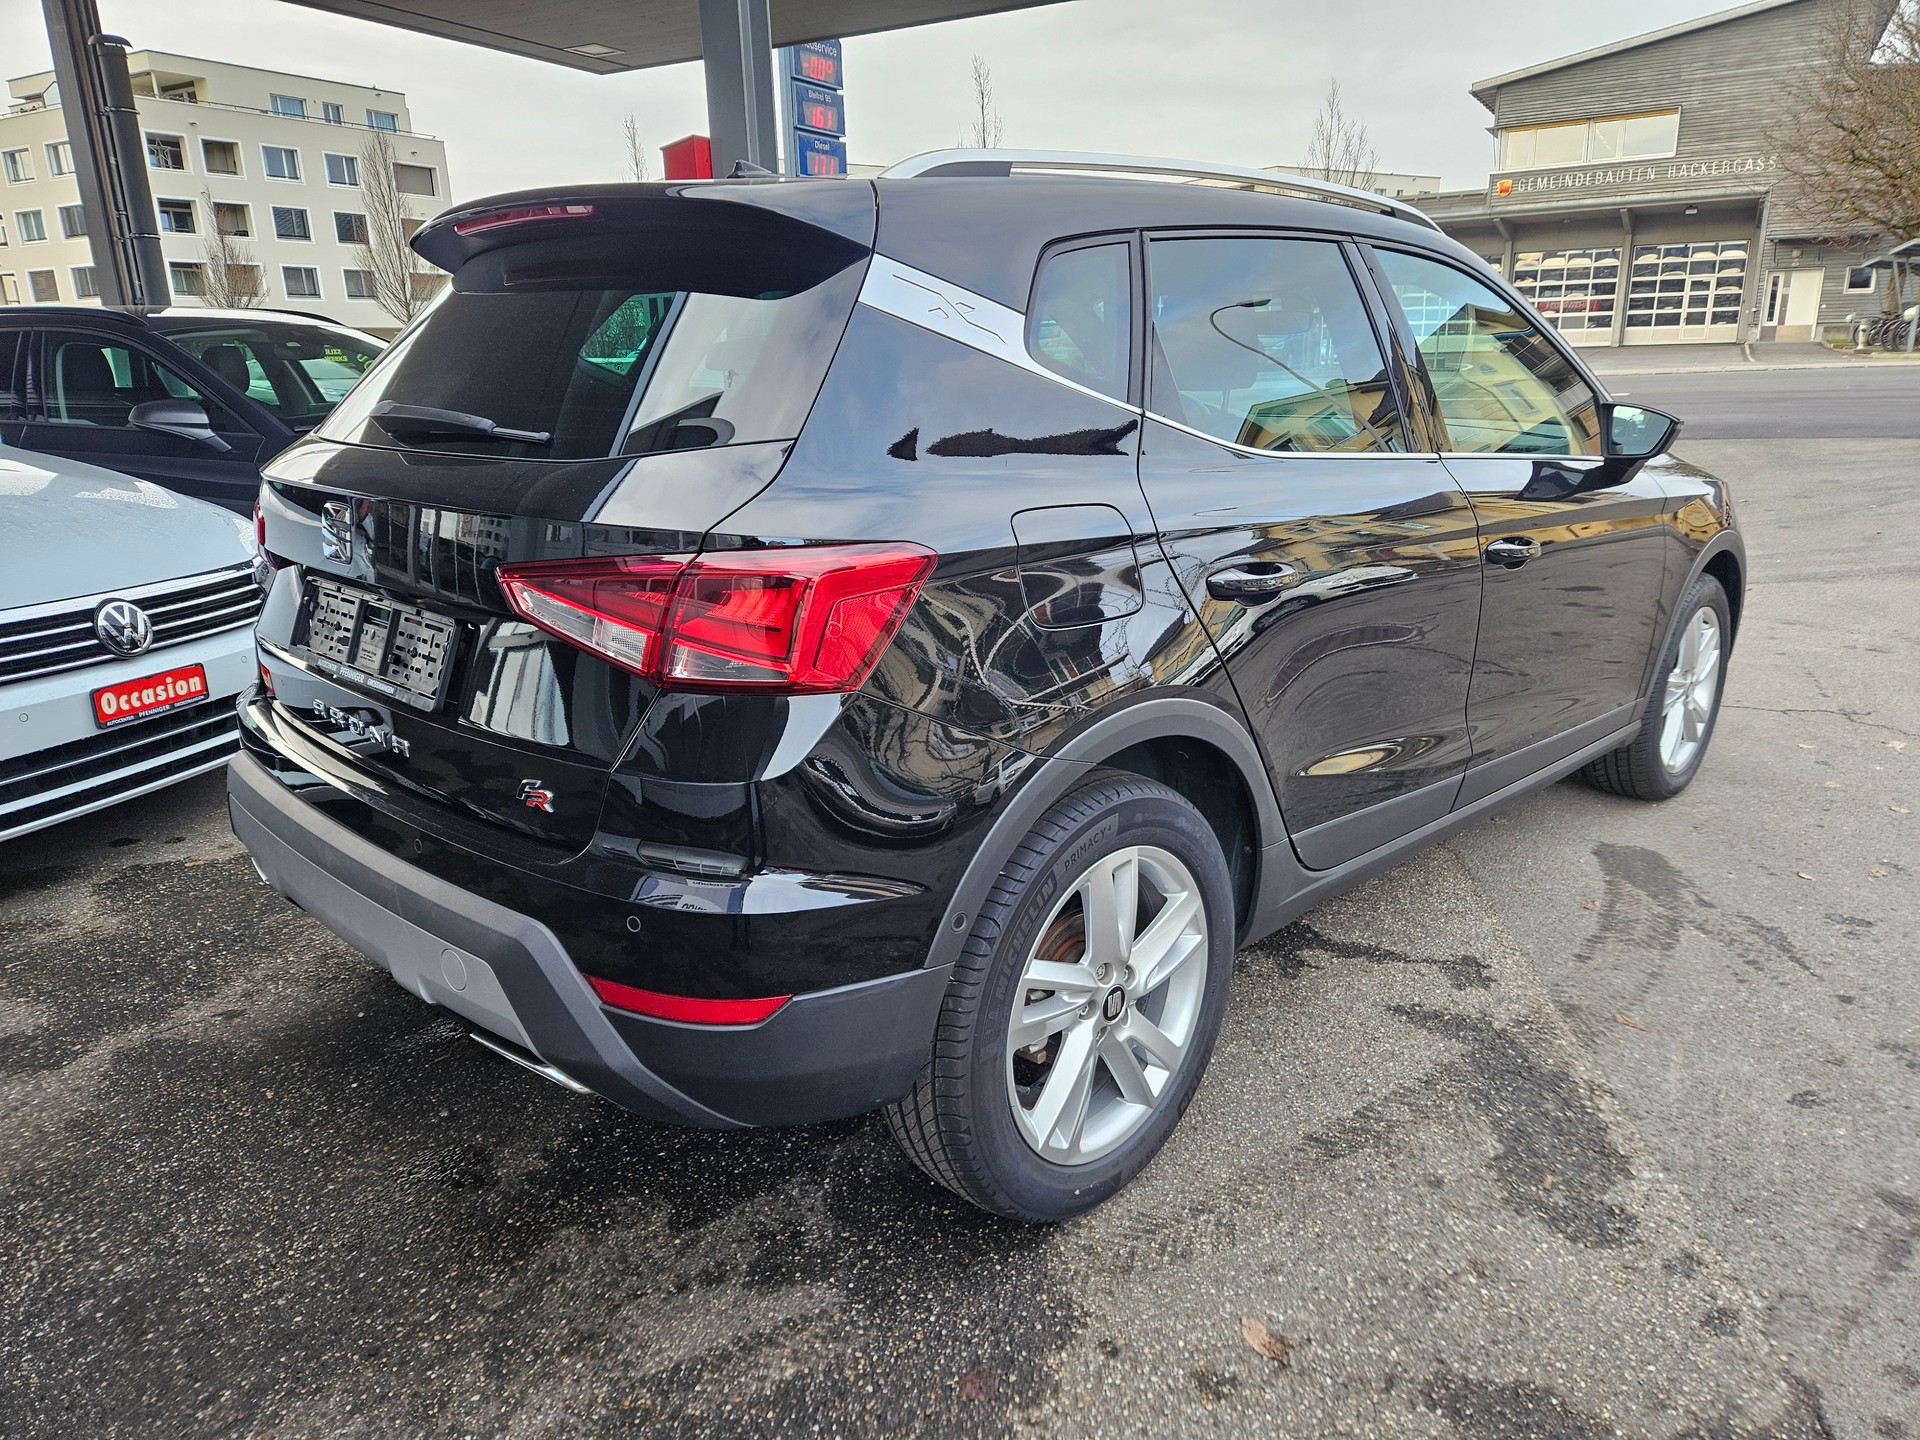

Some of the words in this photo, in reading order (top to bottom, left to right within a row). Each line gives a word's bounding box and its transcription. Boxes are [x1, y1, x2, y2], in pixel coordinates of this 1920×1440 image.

[811, 106, 833, 129] 161
[814, 140, 830, 151] Diesel
[814, 154, 835, 176] 171
[1518, 166, 1656, 193] GEMEINDEBAUTEN
[339, 666, 365, 684] PFENNIGER
[100, 676, 202, 715] Occasion
[138, 704, 170, 718] PFENNIGER
[515, 778, 555, 813] FR
[995, 877, 1056, 1003] MICHELIN
[1064, 828, 1107, 872] PRIMACY
